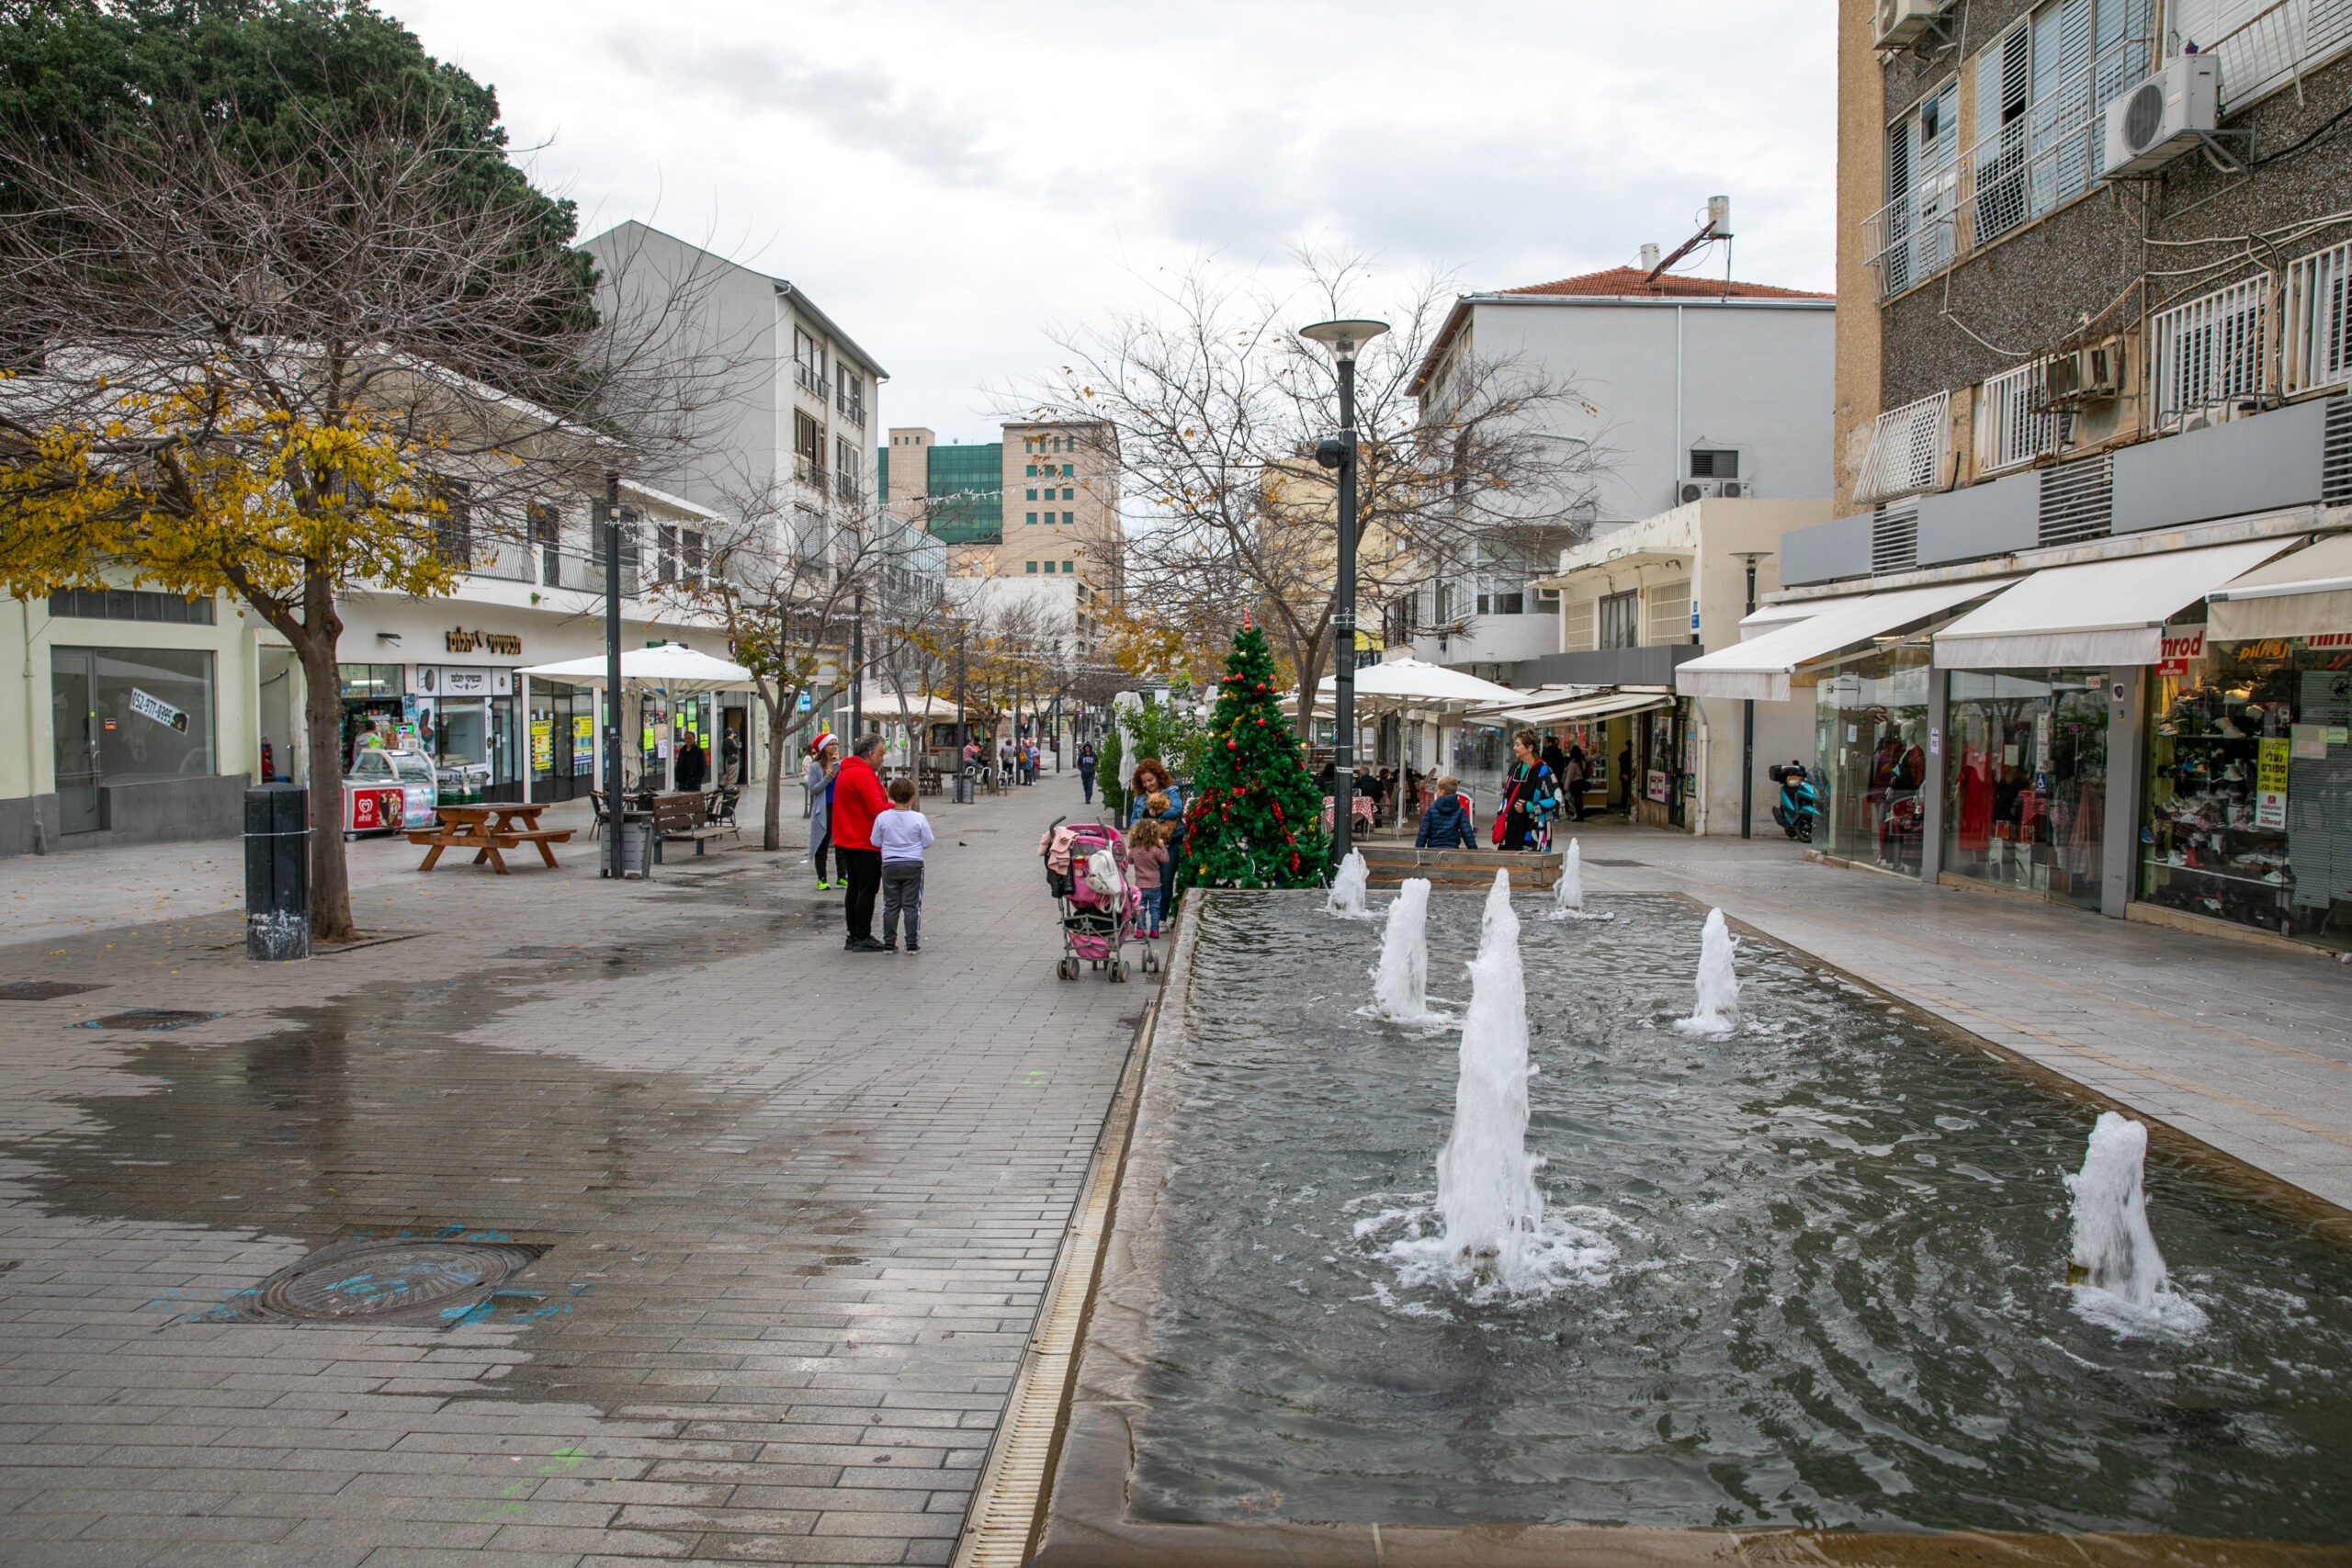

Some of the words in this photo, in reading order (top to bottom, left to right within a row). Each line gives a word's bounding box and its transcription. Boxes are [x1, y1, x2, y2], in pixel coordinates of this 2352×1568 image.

[446, 626, 475, 652] יהלום
[486, 634, 522, 655] תכשיטי
[2265, 750, 2283, 762] נעלי
[2261, 763, 2286, 773] ספורט
